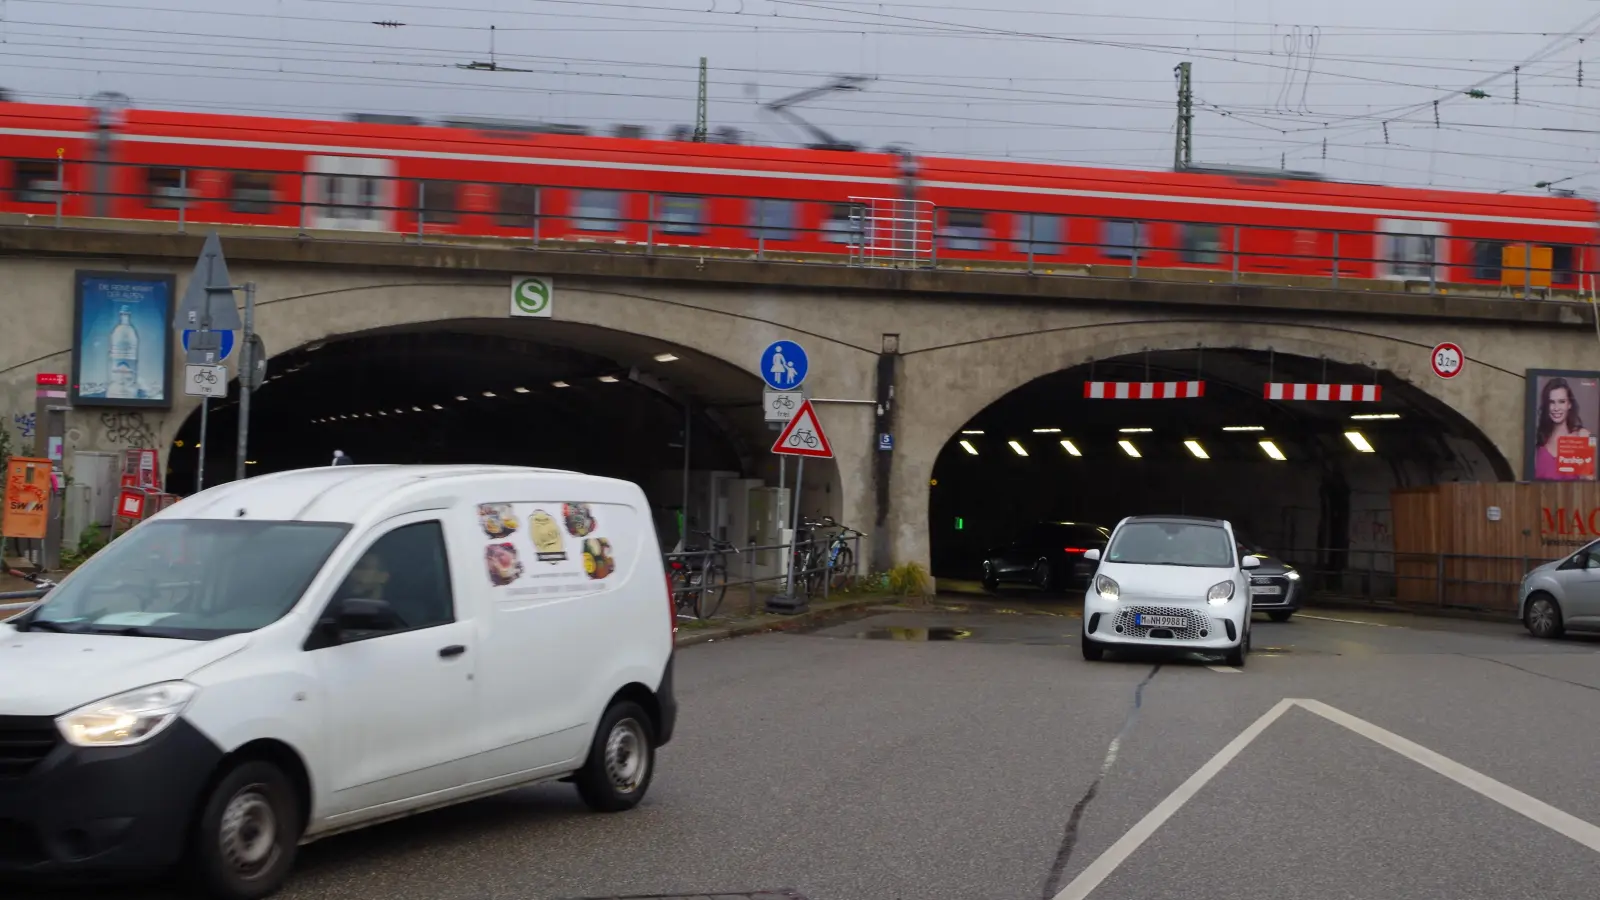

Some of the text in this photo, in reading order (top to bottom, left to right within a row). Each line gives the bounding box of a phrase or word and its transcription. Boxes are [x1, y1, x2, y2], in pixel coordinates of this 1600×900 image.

[521, 282, 544, 310] S
[883, 435, 890, 443] 5
[1141, 615, 1147, 624] M
